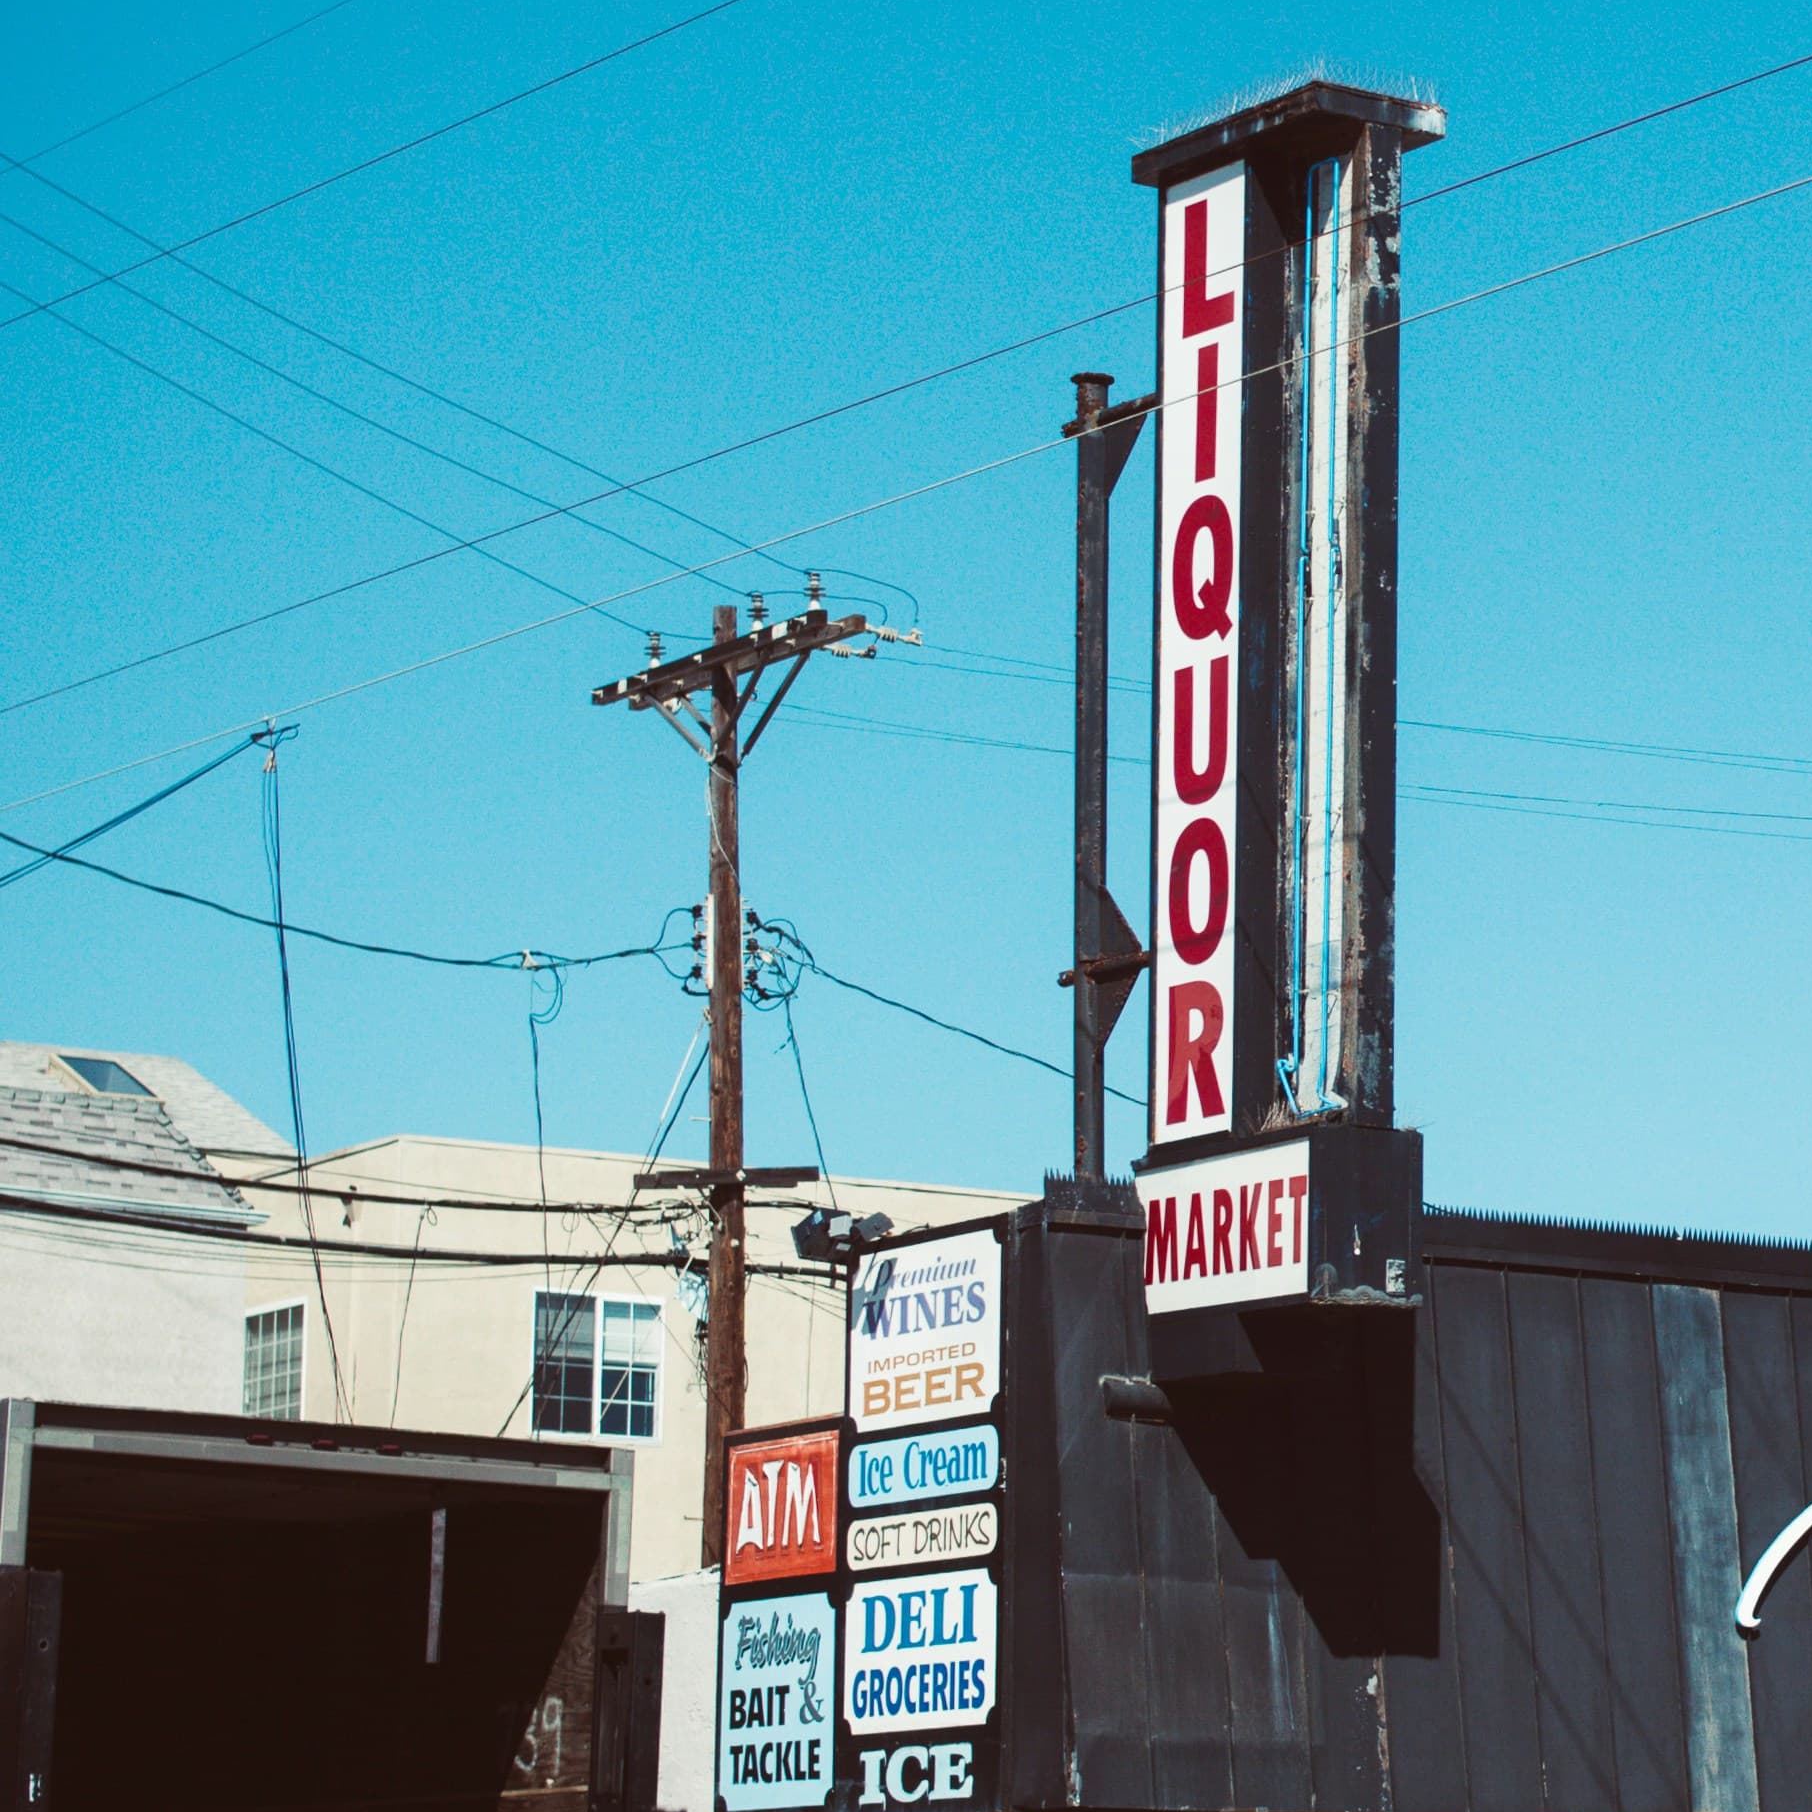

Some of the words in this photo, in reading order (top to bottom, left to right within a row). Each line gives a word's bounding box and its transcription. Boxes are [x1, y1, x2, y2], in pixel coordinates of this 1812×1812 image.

[1166, 198, 1235, 1126] LIQUOR
[1144, 1174, 1309, 1285] MARKET
[870, 1256, 977, 1296] Premium
[862, 1281, 987, 1340] WINES
[868, 1342, 977, 1374] IMPORTED
[863, 1362, 986, 1417] BEER
[858, 1450, 894, 1498] Ice
[904, 1441, 988, 1490] Cream
[735, 1459, 822, 1556] ATM
[854, 1522, 906, 1562] SOFT
[913, 1510, 991, 1555] DRINKS
[861, 1583, 980, 1654] DELI
[735, 1612, 822, 1689] Fishing
[729, 1684, 790, 1730] BAIT
[800, 1681, 827, 1724] &
[852, 1658, 986, 1719] GROCERIES
[729, 1738, 822, 1785] TACKLE
[859, 1742, 974, 1811] ICE
